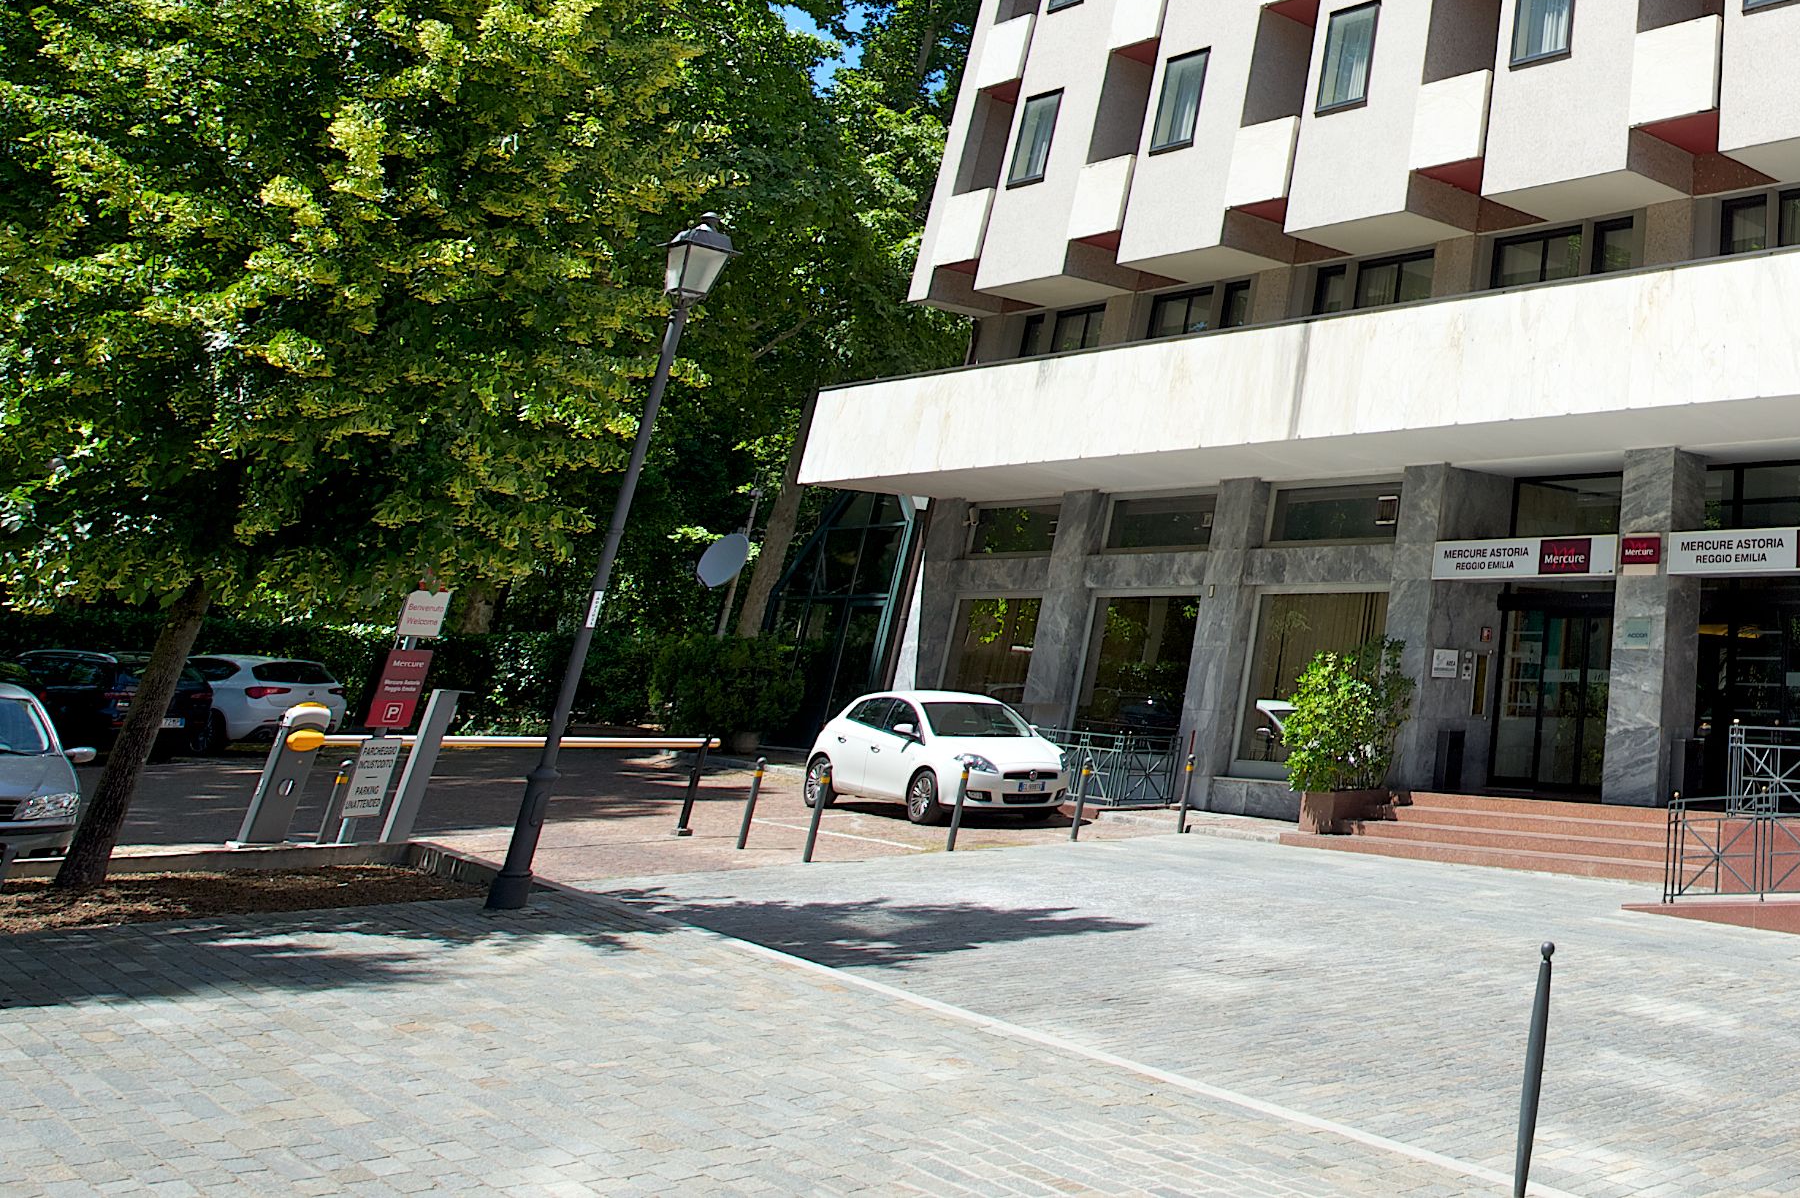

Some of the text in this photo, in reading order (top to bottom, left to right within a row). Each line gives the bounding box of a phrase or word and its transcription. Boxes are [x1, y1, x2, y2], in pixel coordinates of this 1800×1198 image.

[1680, 538, 1784, 551] MERCURE ASTORIA
[1444, 547, 1529, 559] MERCURE ASTORIA
[1624, 548, 1654, 556] Mercure
[1544, 553, 1585, 564] Mercure
[1695, 553, 1767, 564] REGGIO EMILIA
[1455, 560, 1515, 571] REGGIO EMILIA
[407, 603, 445, 612] Benvenuto
[406, 617, 438, 625] Welcome
[393, 660, 425, 668] Mercure
[386, 706, 399, 719] P
[355, 786, 380, 796] PARKING
